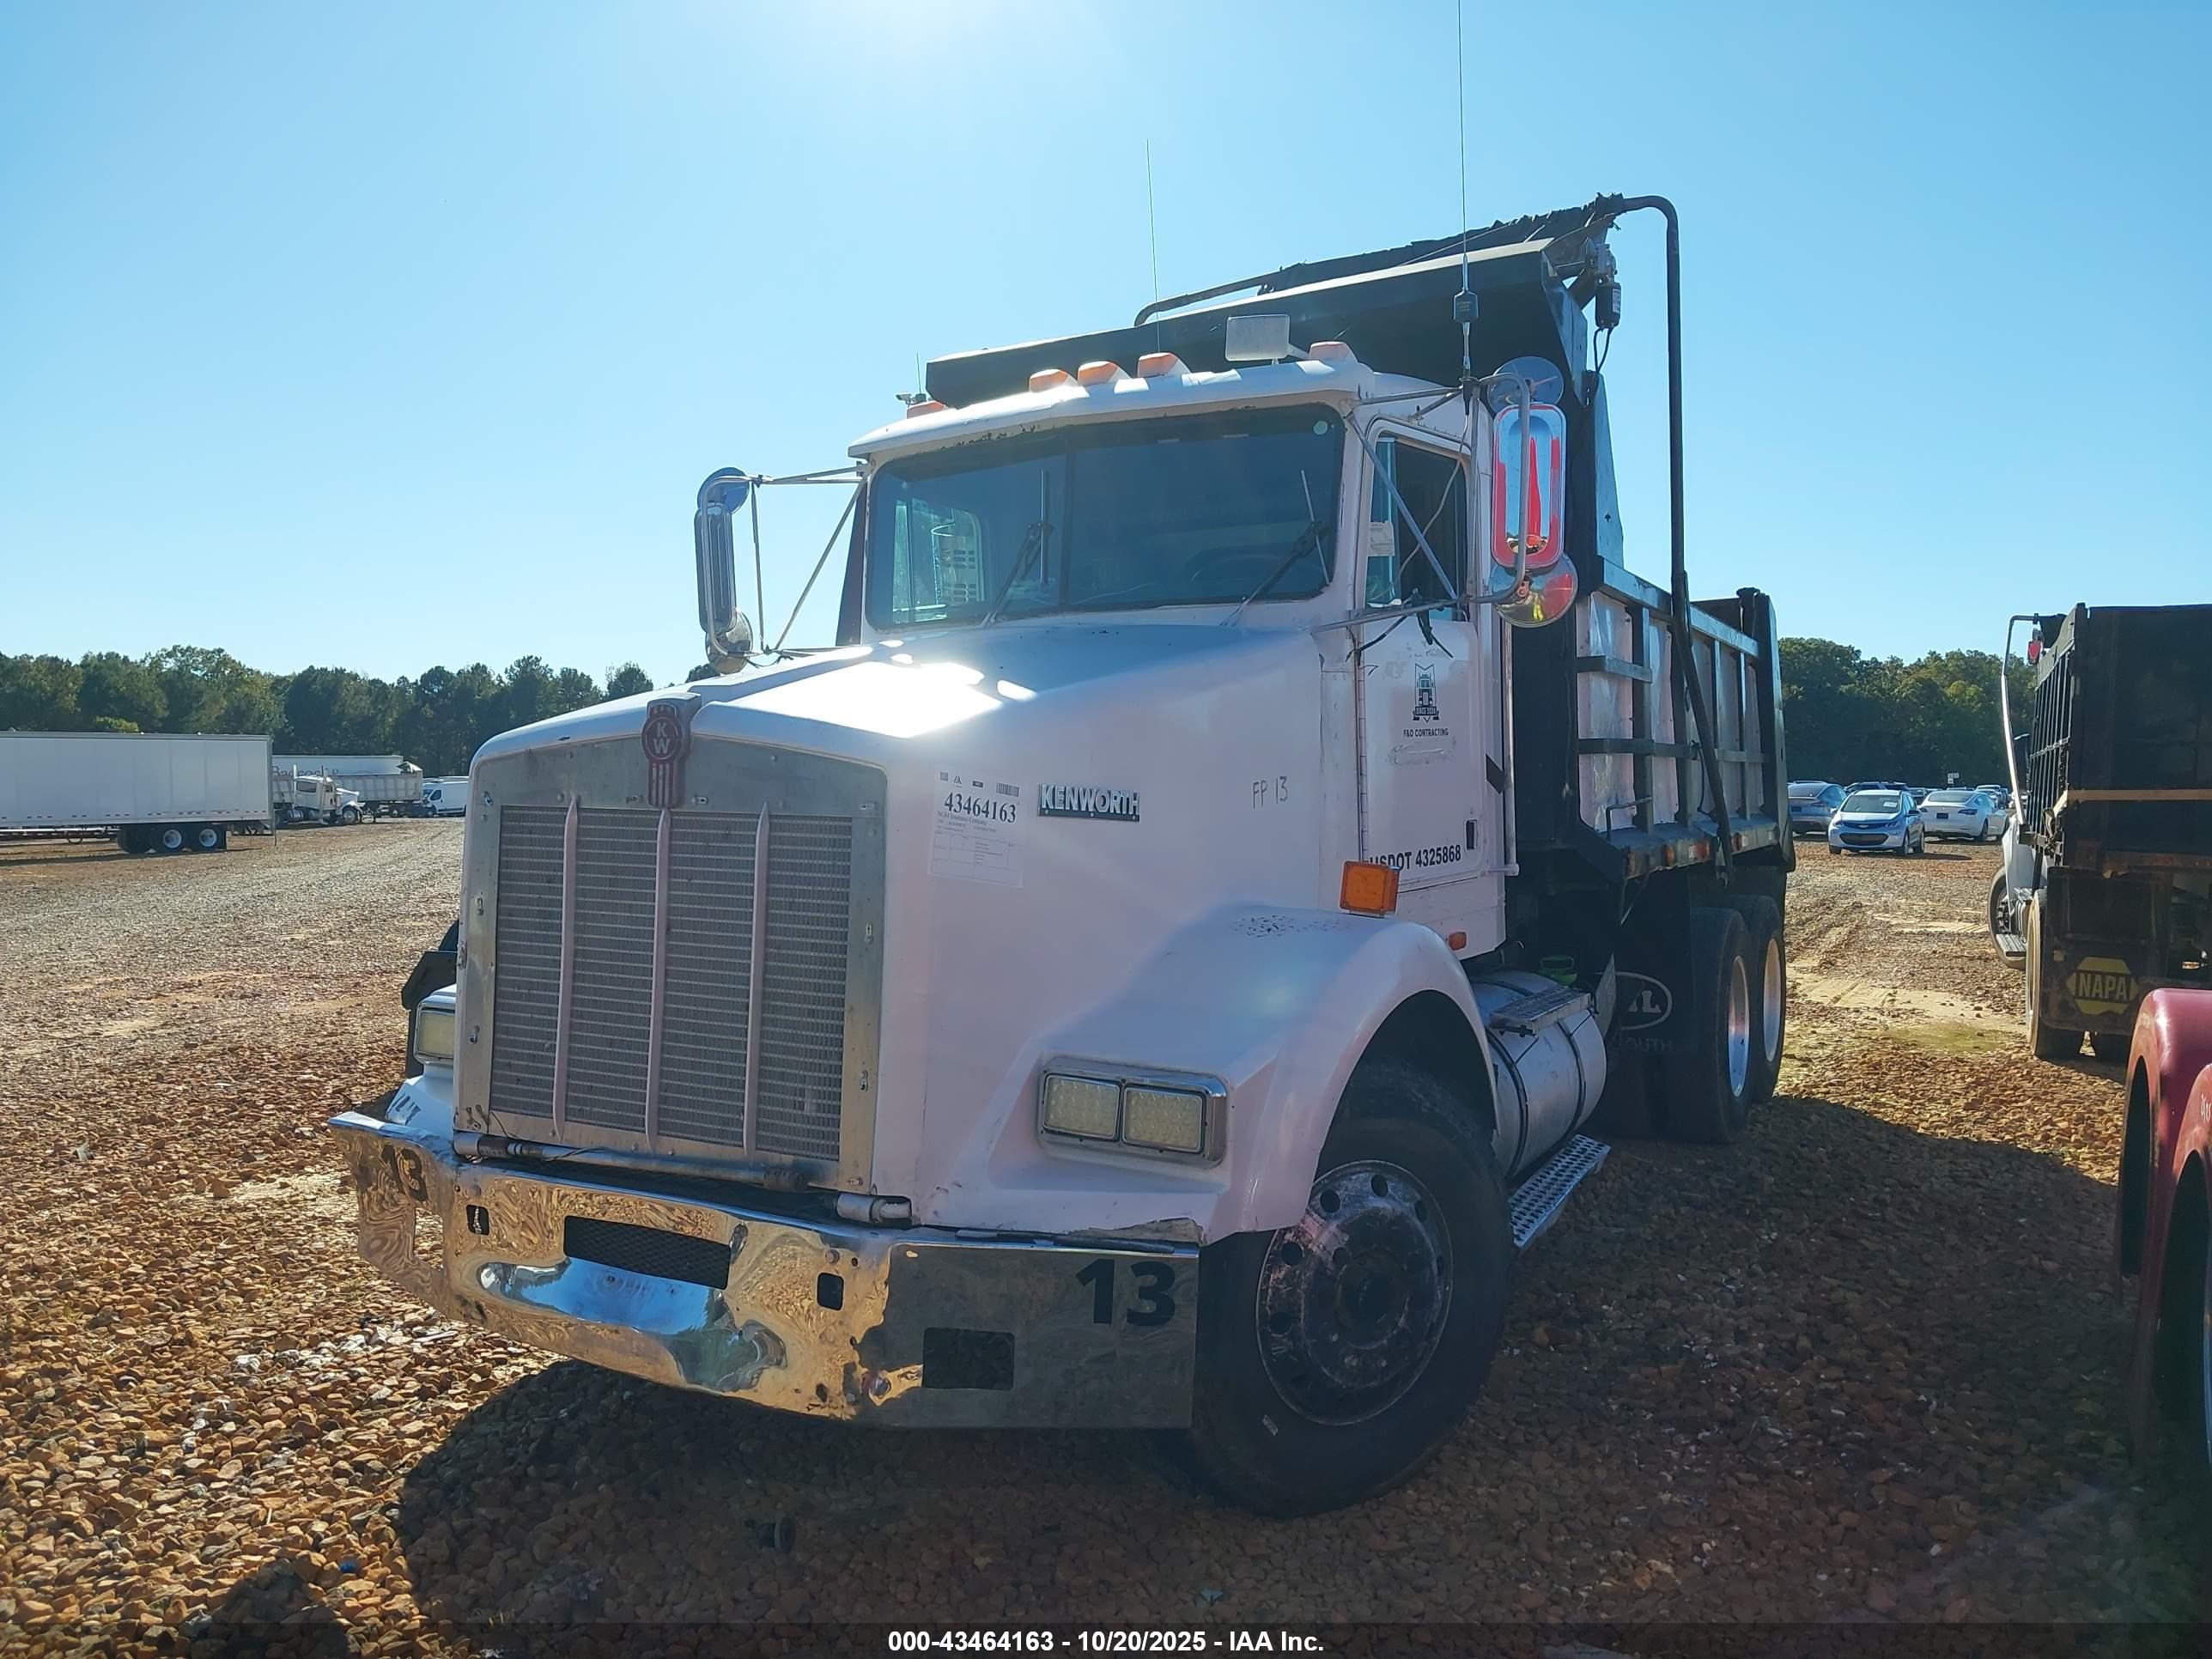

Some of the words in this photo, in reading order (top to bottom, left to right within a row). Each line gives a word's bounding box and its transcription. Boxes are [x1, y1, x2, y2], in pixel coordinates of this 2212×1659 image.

[1415, 727, 1449, 738] CONTRACTING
[944, 791, 1016, 823] 43464163
[1040, 783, 1140, 816] KENWORTH
[1252, 780, 1268, 809] FP
[1275, 775, 1288, 805] 13
[1415, 844, 1462, 868] 4325868
[2077, 973, 2129, 1002] NAPA
[1074, 1257, 1176, 1327] 13
